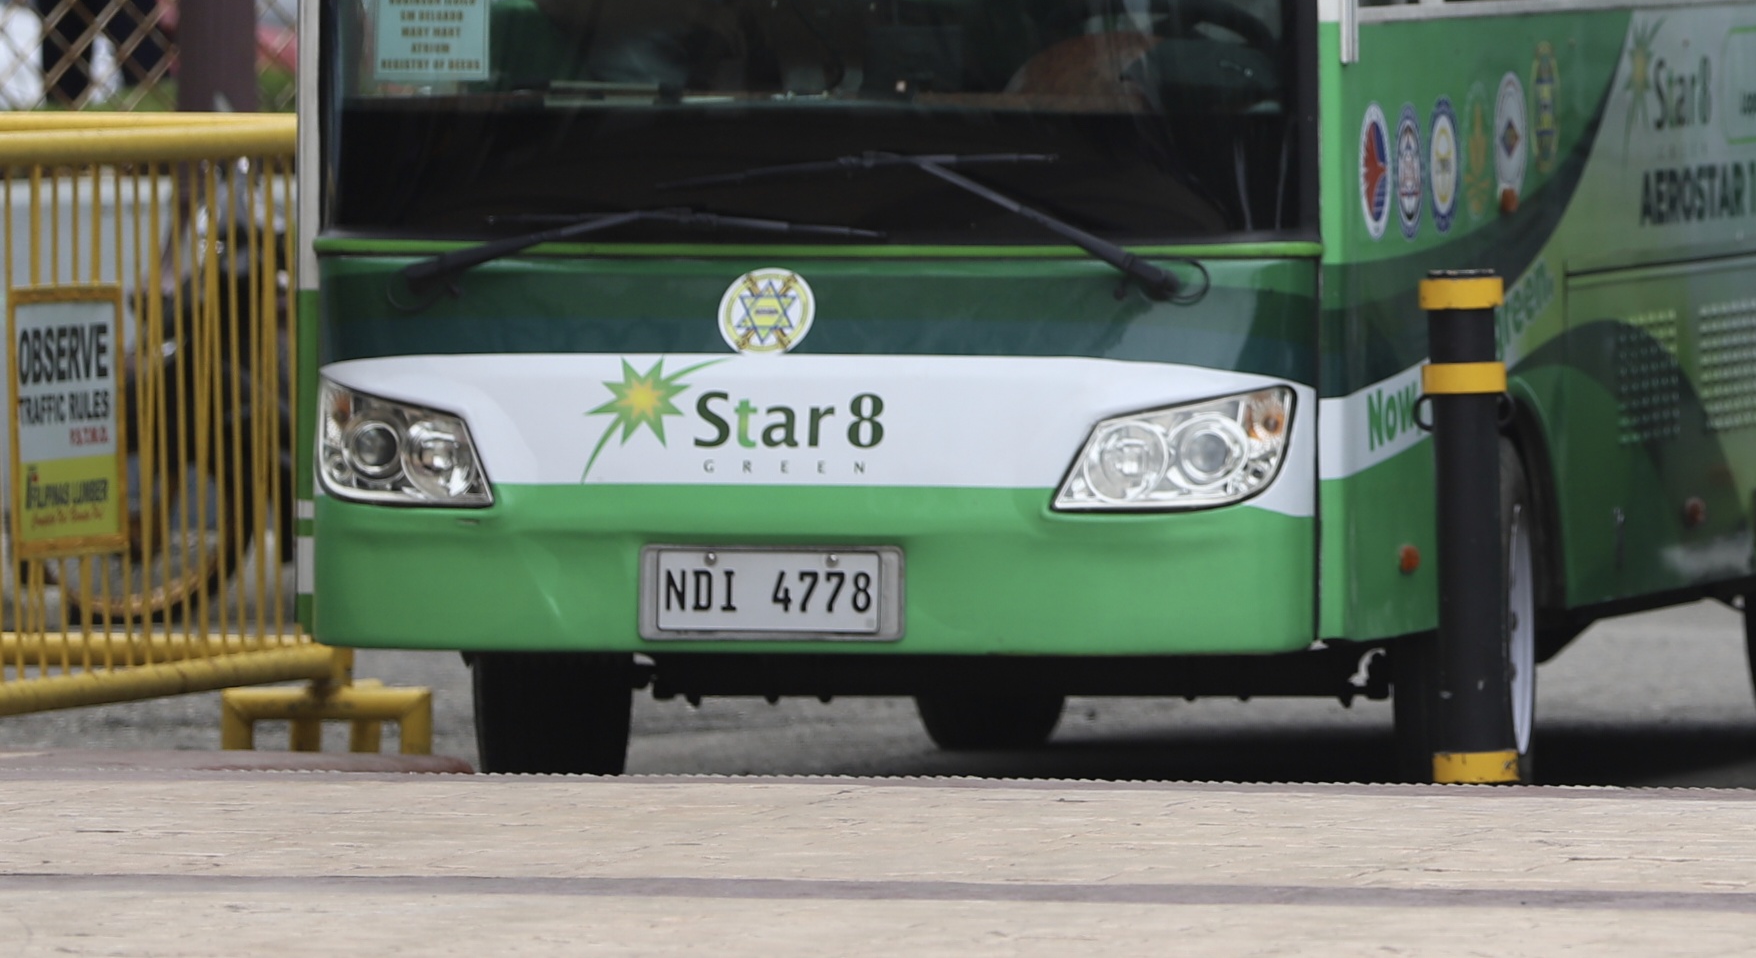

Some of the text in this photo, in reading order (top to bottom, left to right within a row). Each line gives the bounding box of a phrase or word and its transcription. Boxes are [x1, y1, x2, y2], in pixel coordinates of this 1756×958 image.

[18, 324, 109, 385] OBSERVE
[19, 389, 110, 426] TRAFFIC RULES
[702, 458, 866, 475] GREEN
[665, 569, 873, 612] NDI 4778
